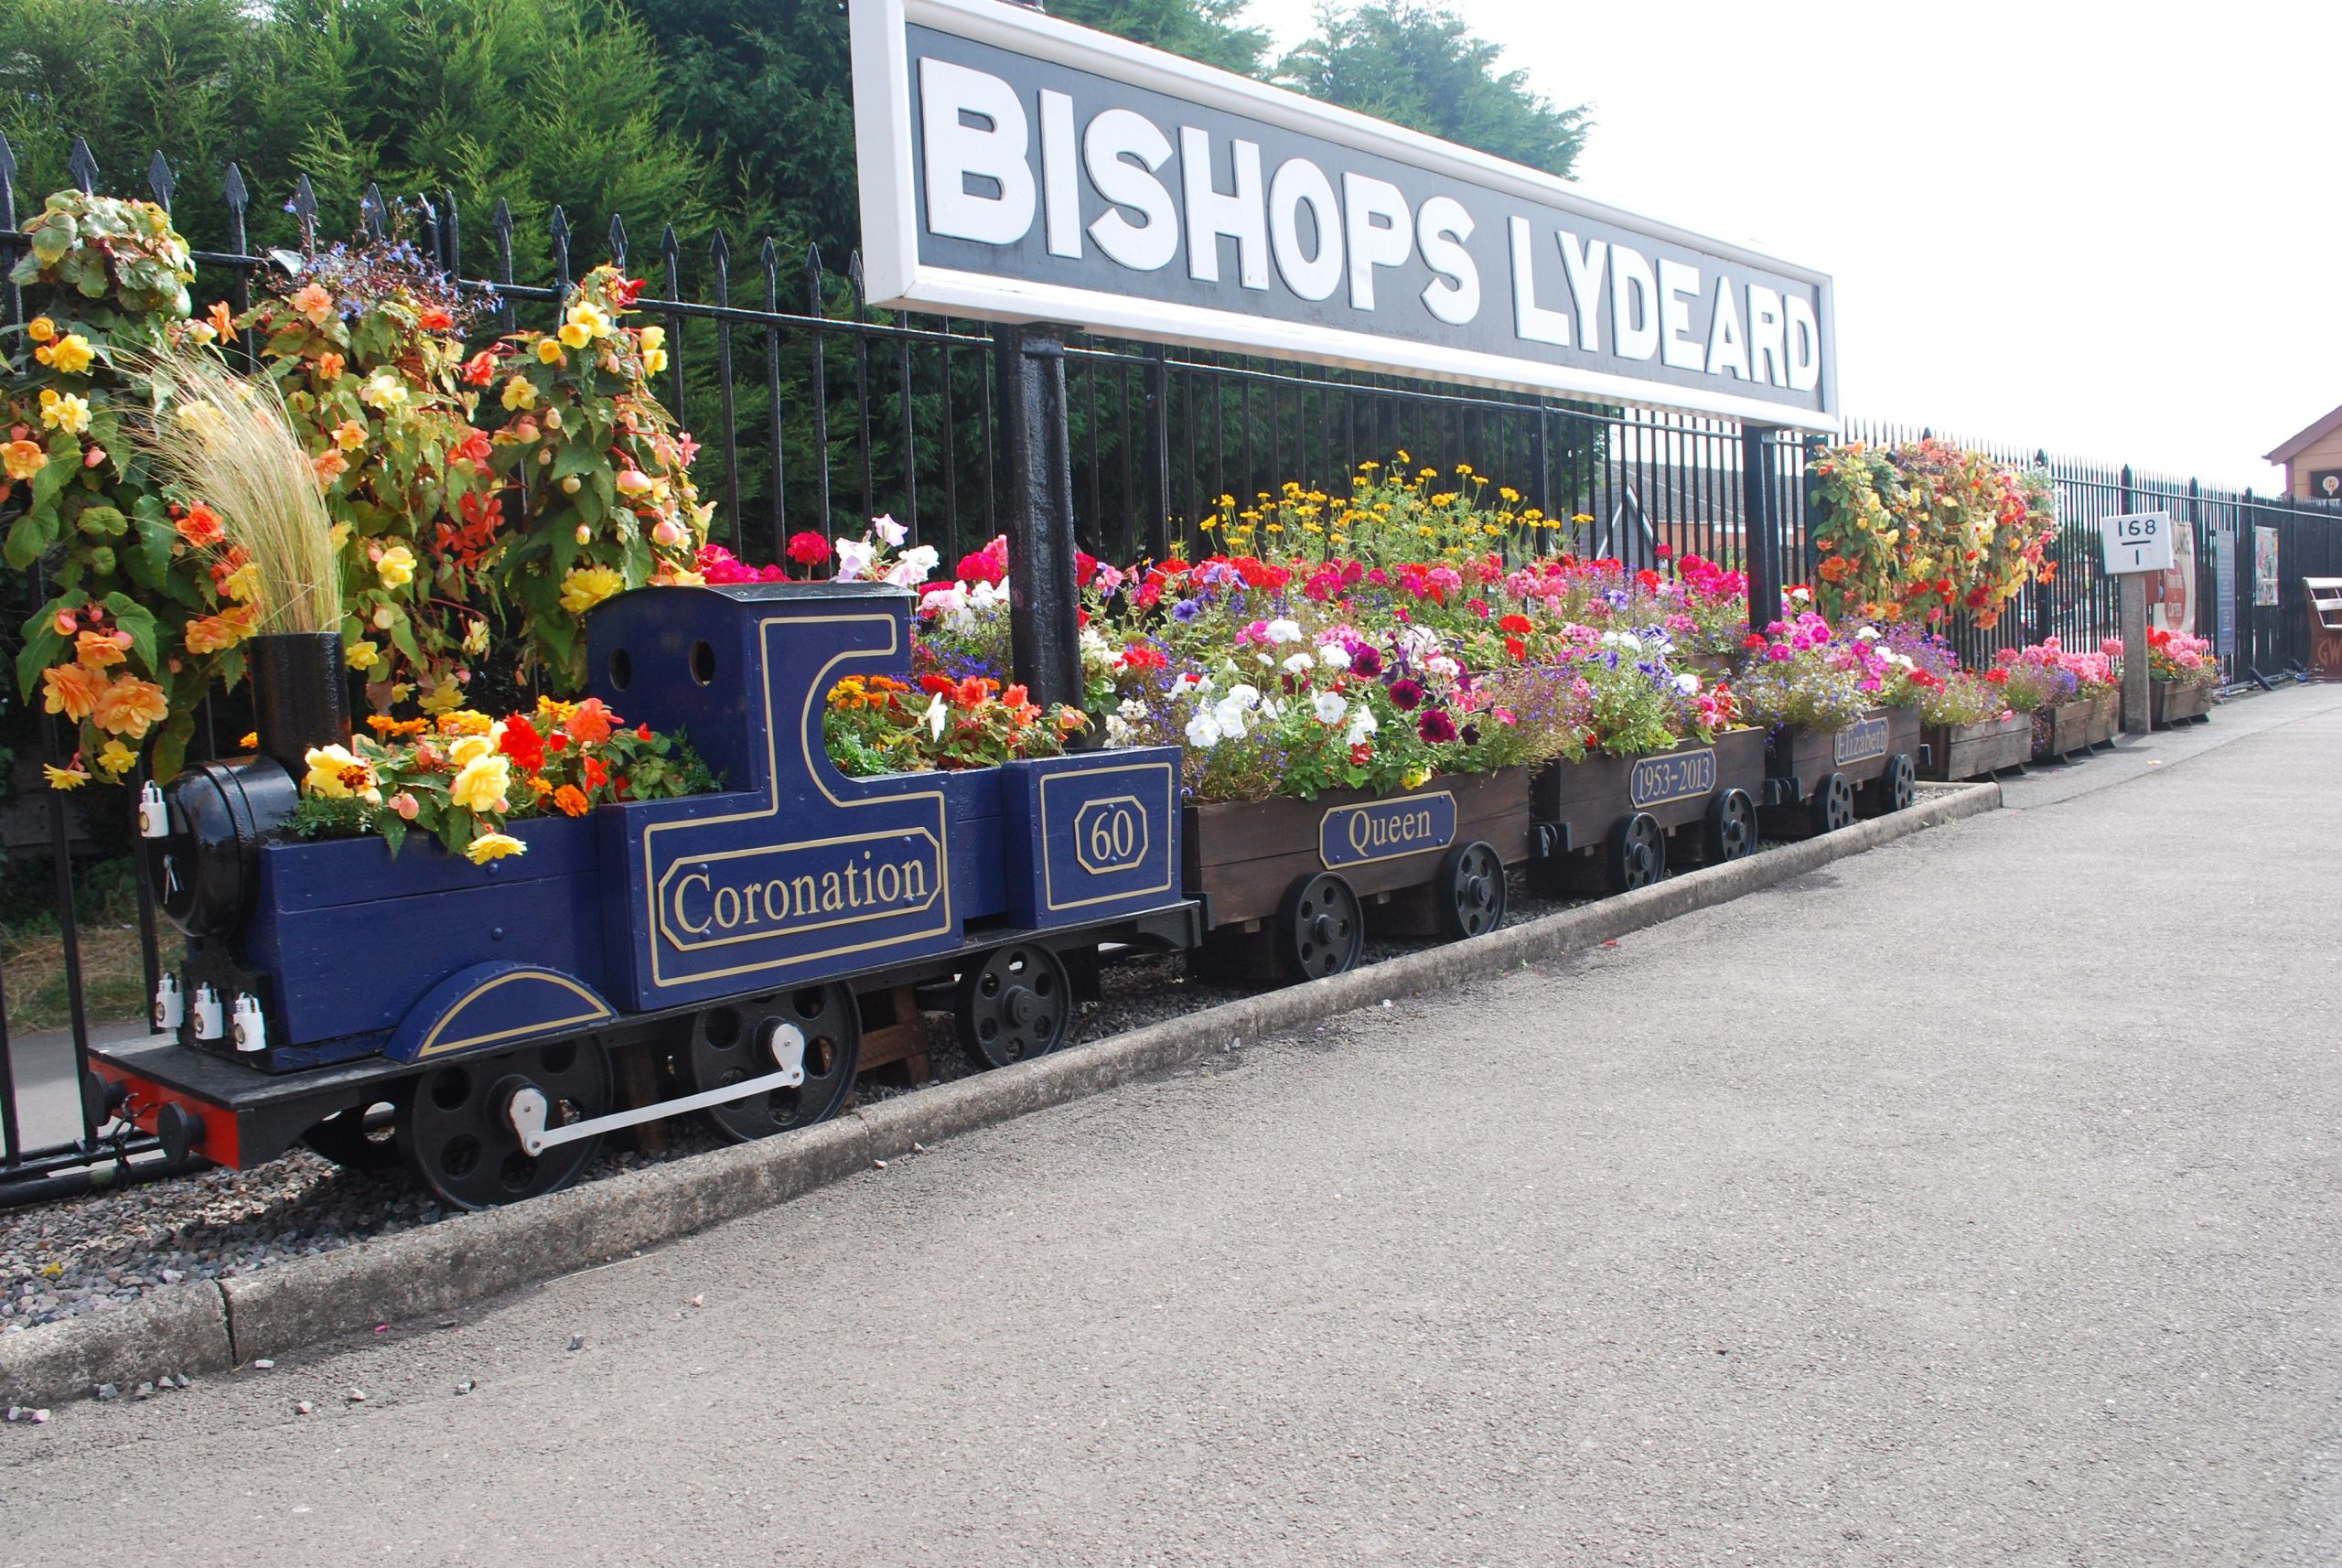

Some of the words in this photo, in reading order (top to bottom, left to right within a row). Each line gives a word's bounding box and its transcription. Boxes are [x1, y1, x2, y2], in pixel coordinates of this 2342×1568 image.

[919, 56, 1481, 325] BISHOPS
[1509, 216, 1820, 392] LYDEARD
[2118, 519, 2156, 537] 168
[2135, 549, 2140, 565] 1
[1838, 725, 1886, 759] Elizabeth
[1638, 757, 1711, 799] 1953-2013
[1091, 810, 1134, 862] 60
[1348, 811, 1433, 857] Queen
[673, 851, 928, 933] Coronation
